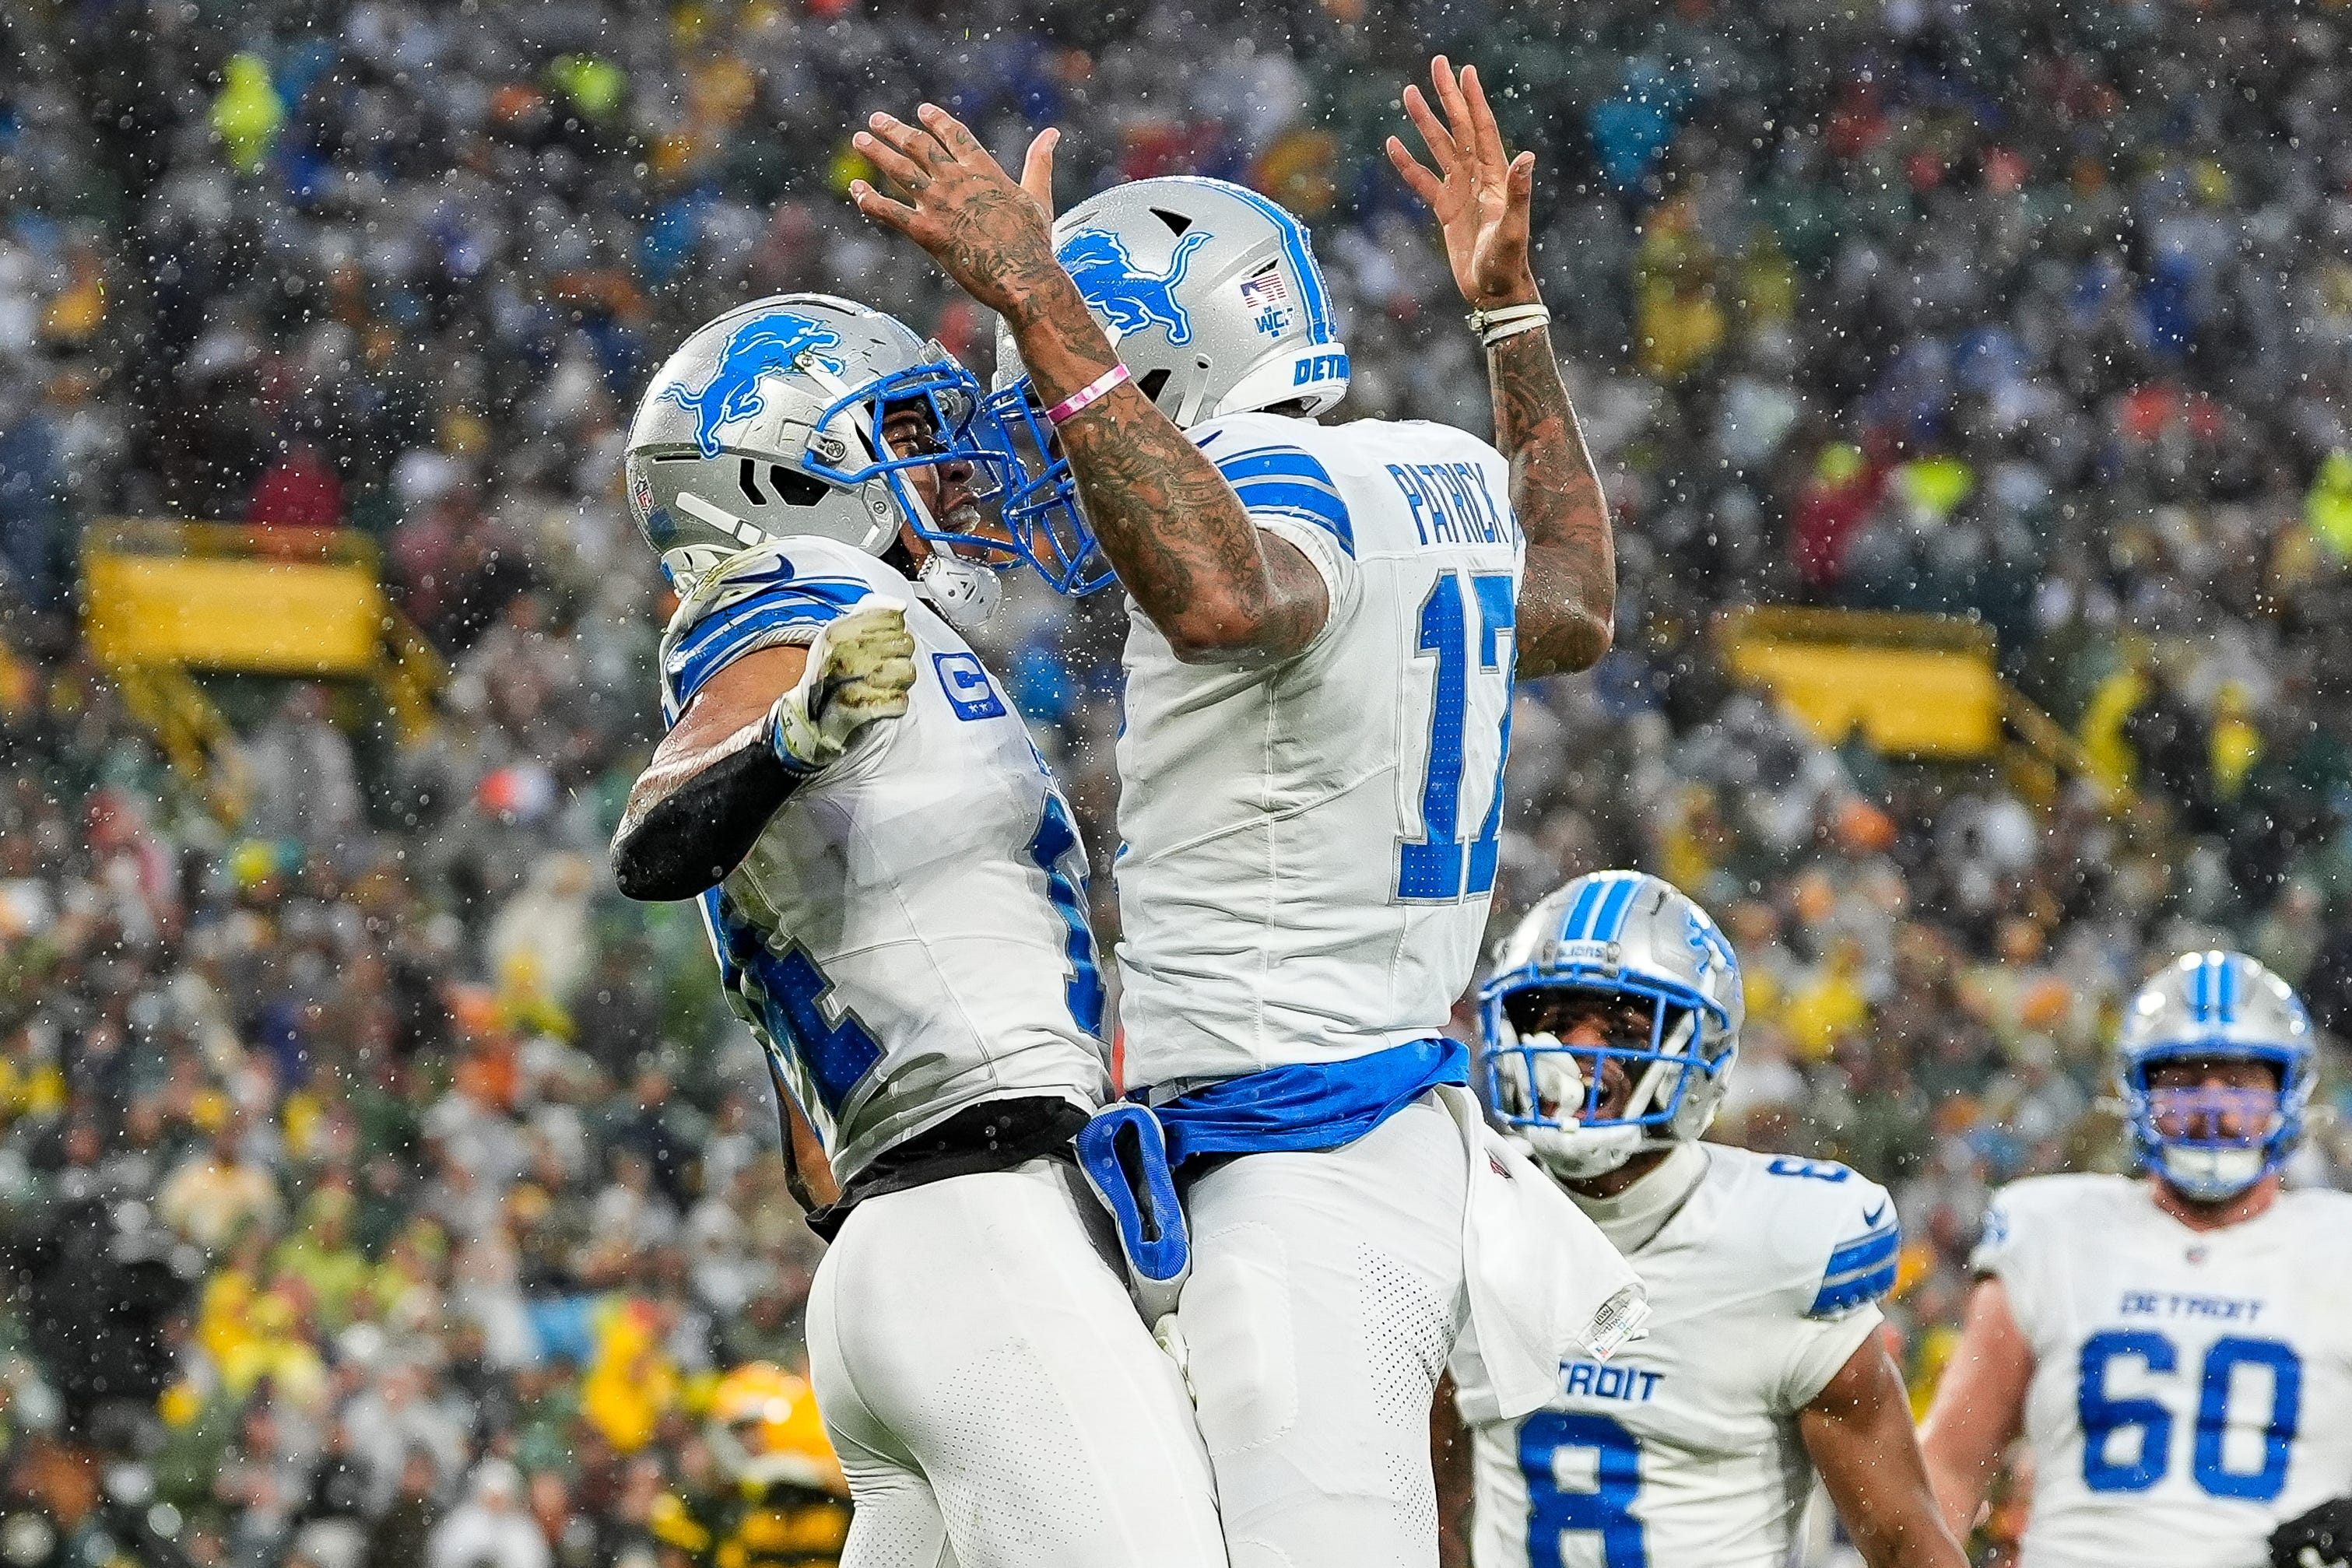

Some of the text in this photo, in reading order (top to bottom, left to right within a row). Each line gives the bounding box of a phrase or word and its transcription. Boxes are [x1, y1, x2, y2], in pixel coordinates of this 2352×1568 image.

[1385, 462, 1509, 545] PATRICK
[939, 658, 990, 703] C
[1388, 568, 1518, 906] 17
[2121, 1289, 2266, 1324] DETROIT
[2079, 1329, 2303, 1503] 60
[1518, 1410, 1650, 1568] 8
